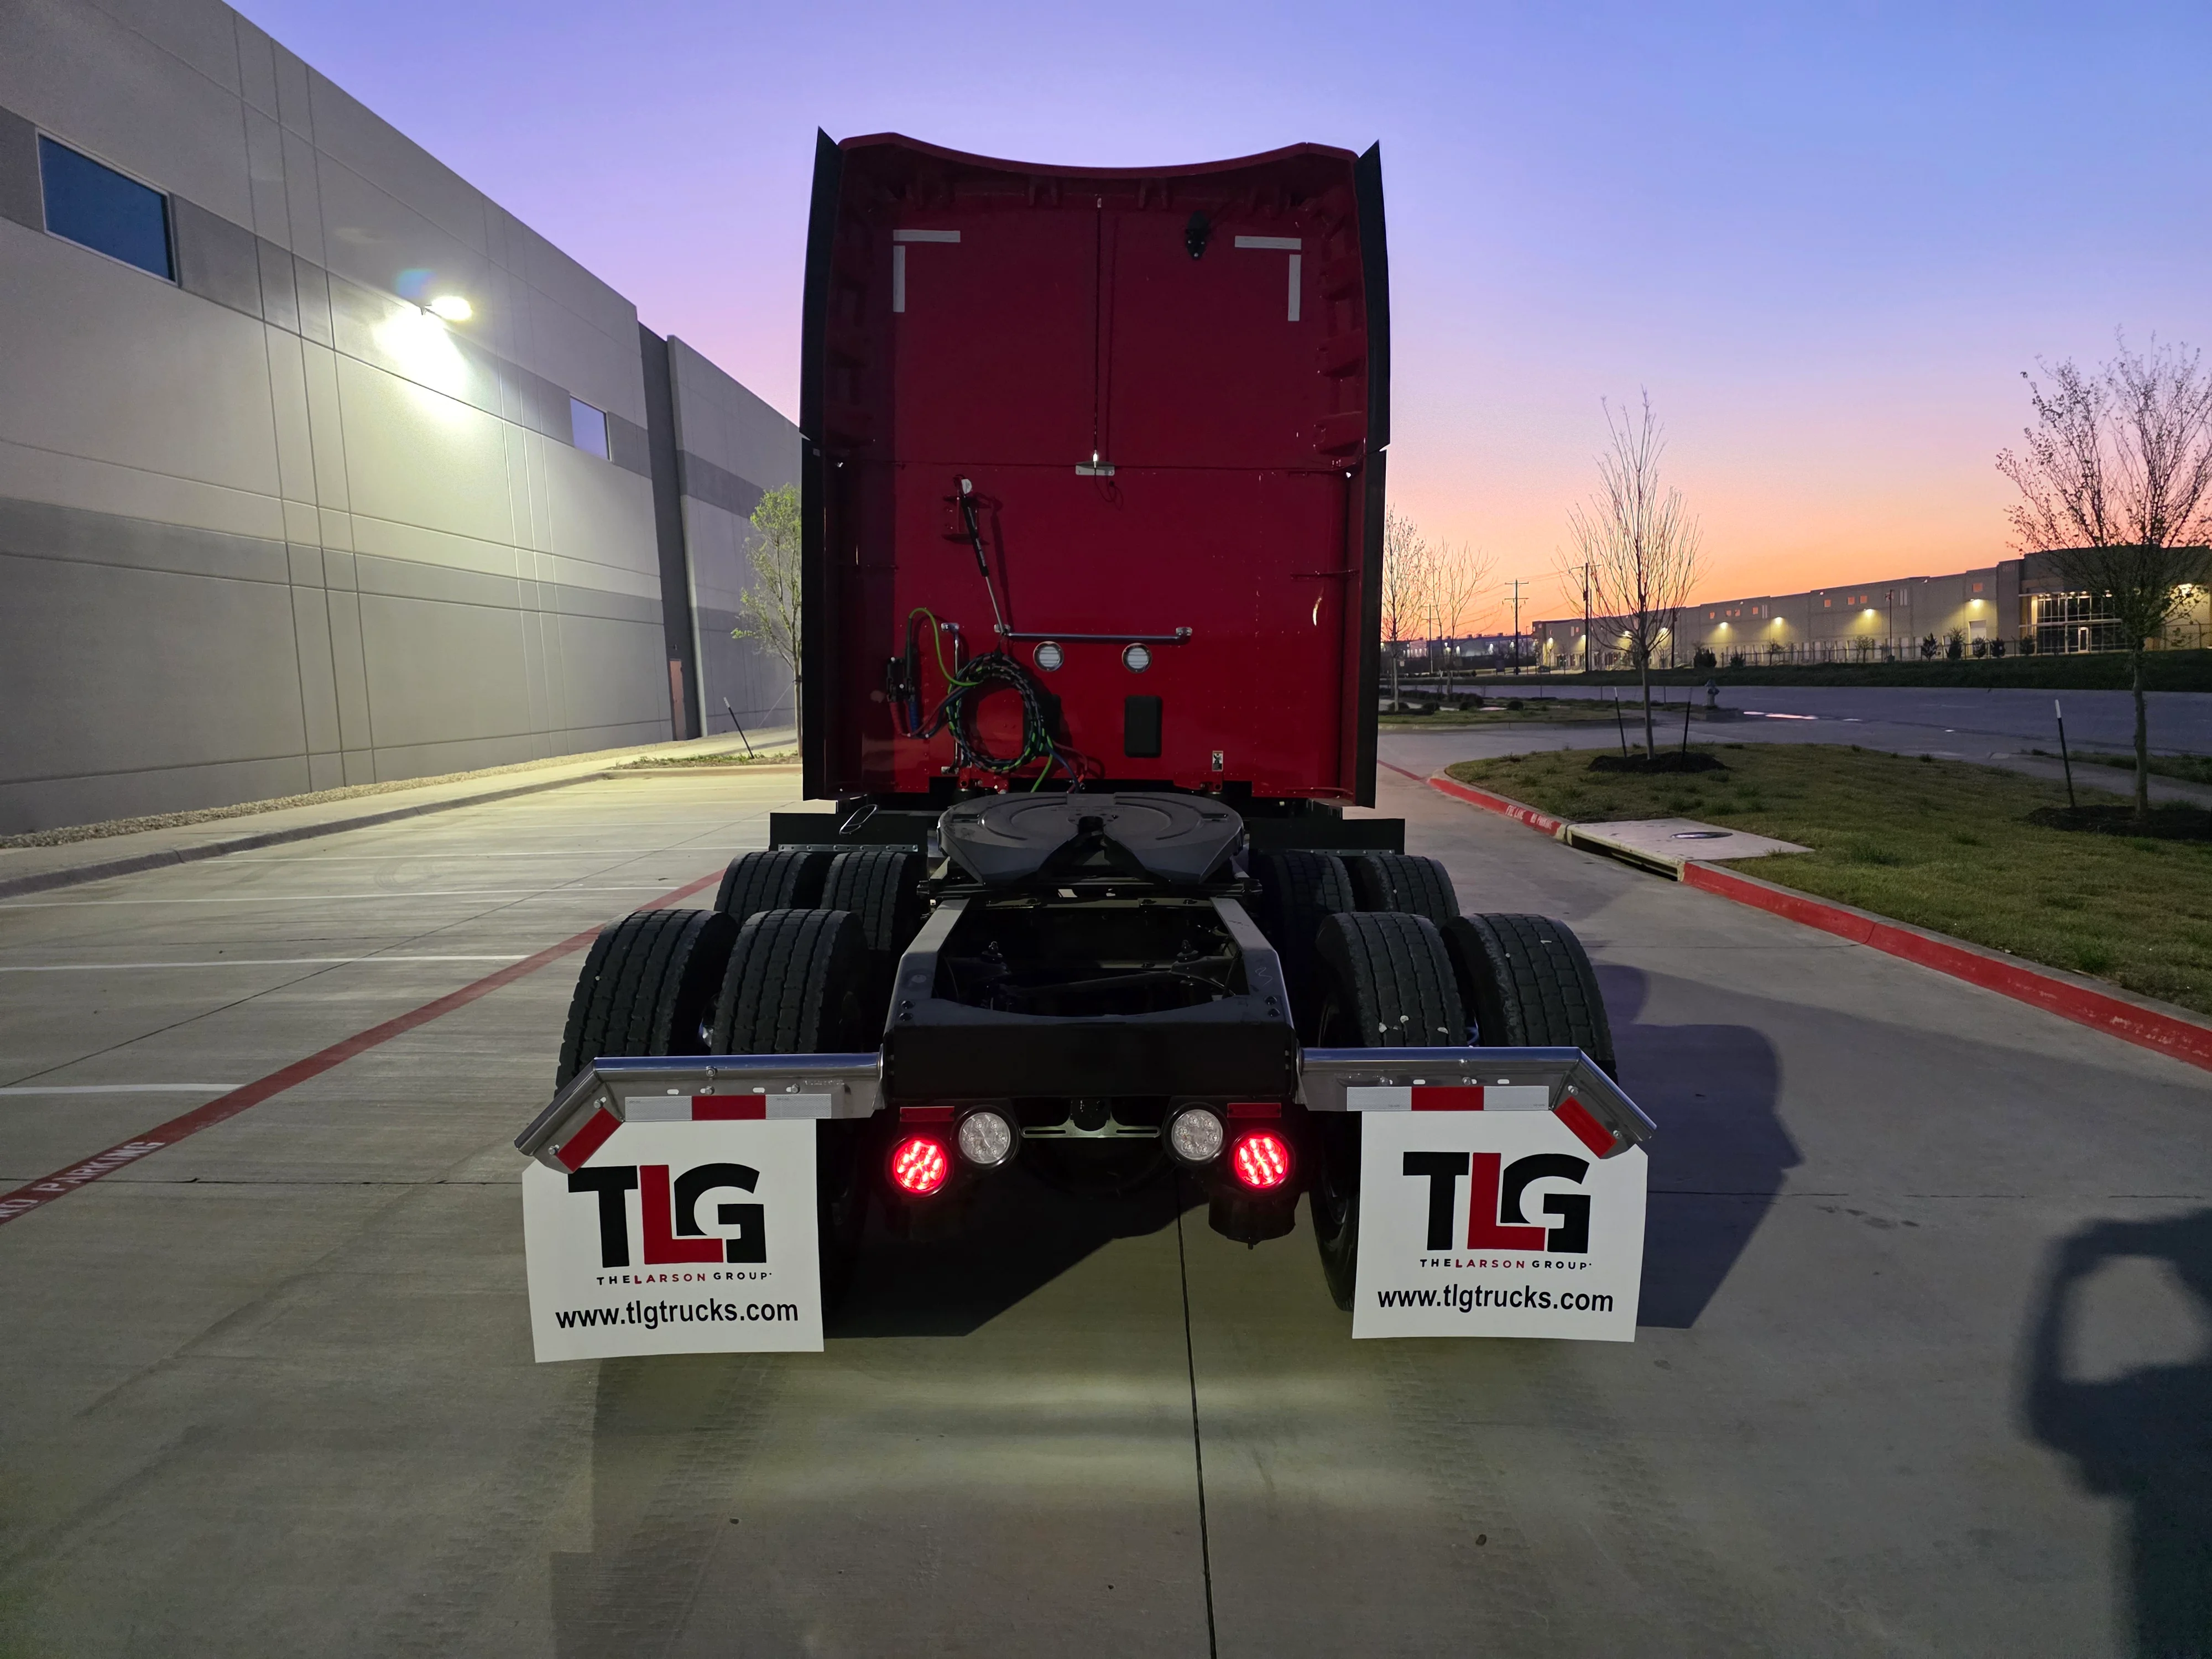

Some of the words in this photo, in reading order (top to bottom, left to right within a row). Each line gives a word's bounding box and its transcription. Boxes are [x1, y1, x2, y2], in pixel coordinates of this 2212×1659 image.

[32, 1141, 166, 1192] PARKING
[567, 1162, 767, 1269] TLG
[1403, 1151, 1591, 1254] TLG
[713, 1272, 768, 1280] GROUP
[1532, 1260, 1587, 1270] GROUP
[555, 1298, 798, 1329] www.tlgtrucks.com
[1378, 1284, 1613, 1313] www.tlgtrucks.com
